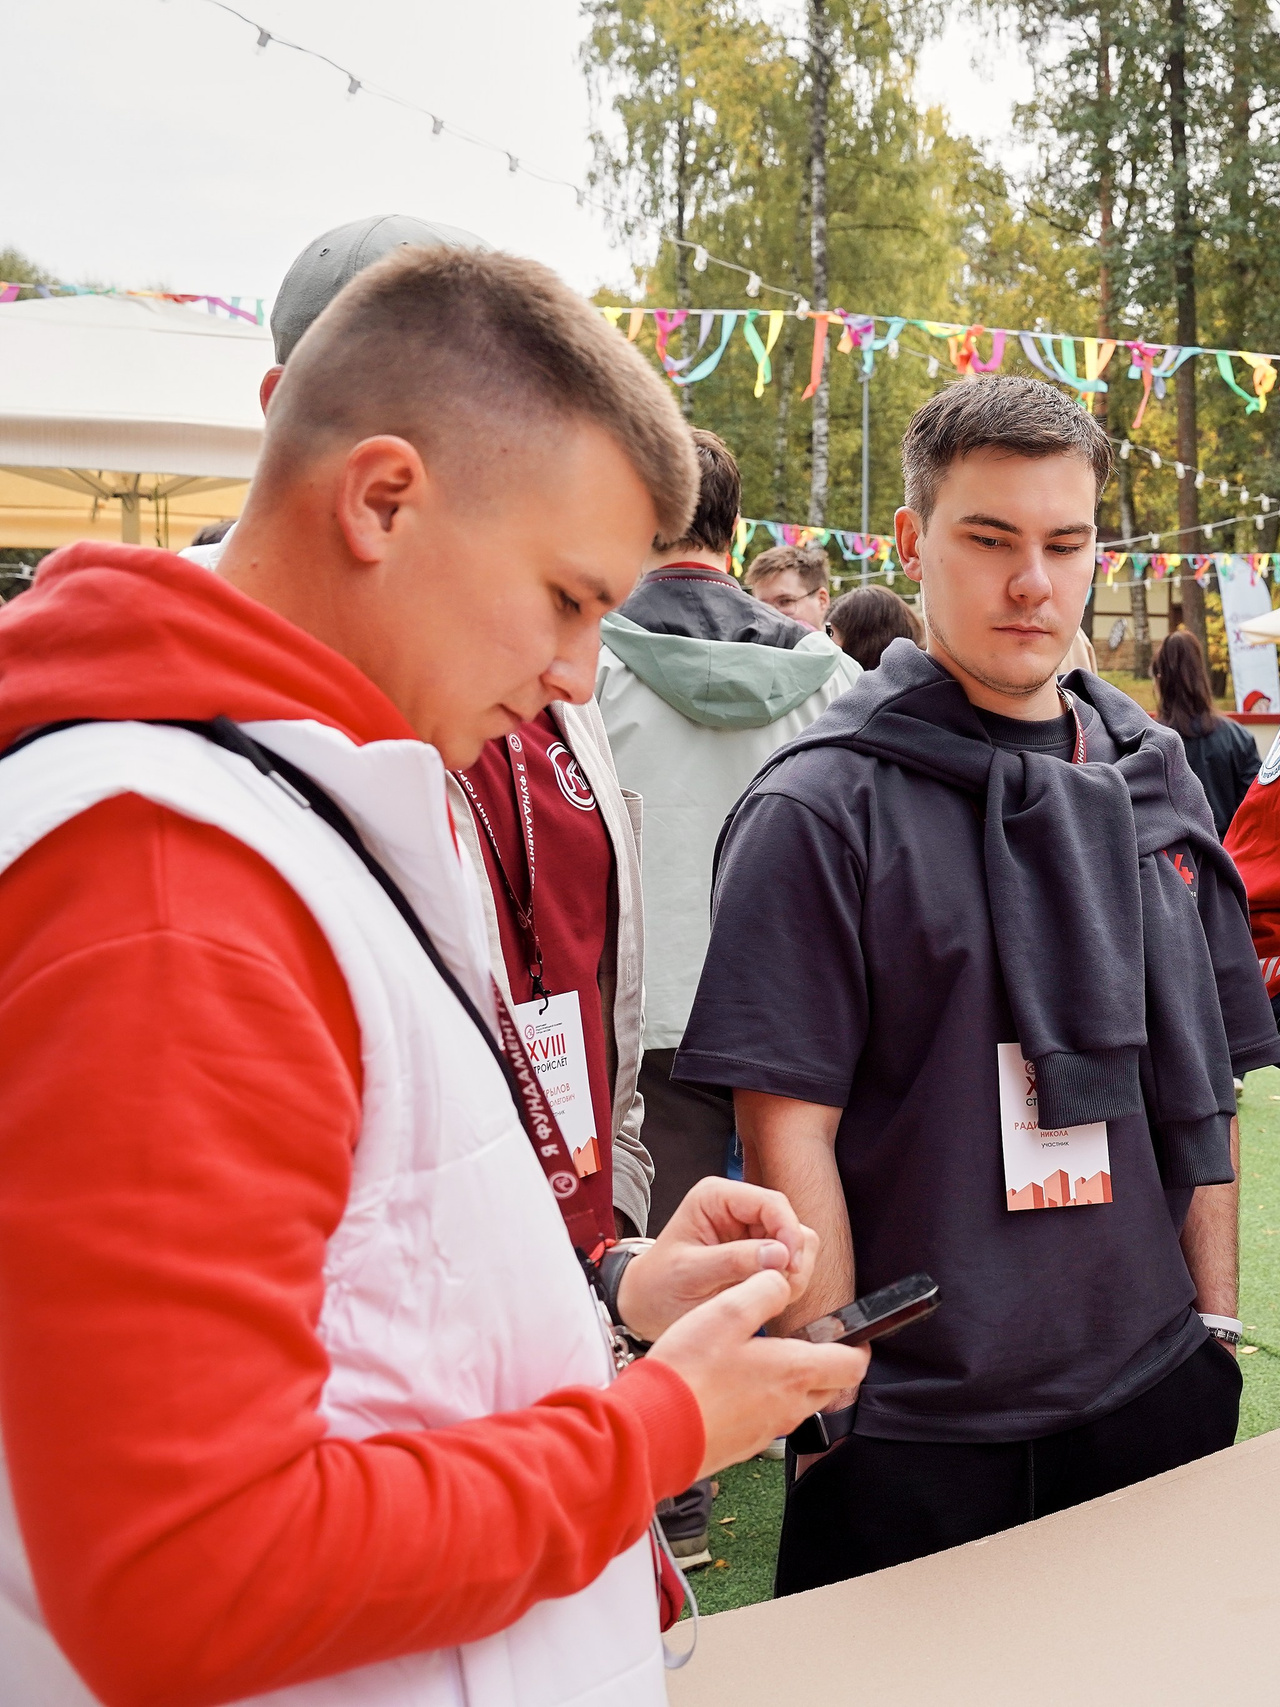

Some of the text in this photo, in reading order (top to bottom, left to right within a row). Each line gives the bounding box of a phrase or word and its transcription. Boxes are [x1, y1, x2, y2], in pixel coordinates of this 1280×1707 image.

[516, 762, 526, 772] Я
[526, 1032, 566, 1062] XVIII
[533, 1055, 568, 1075] ТРОЙСЛЁТ
[1040, 1129, 1069, 1138] НИКОЛА
[540, 1143, 561, 1159] Я
